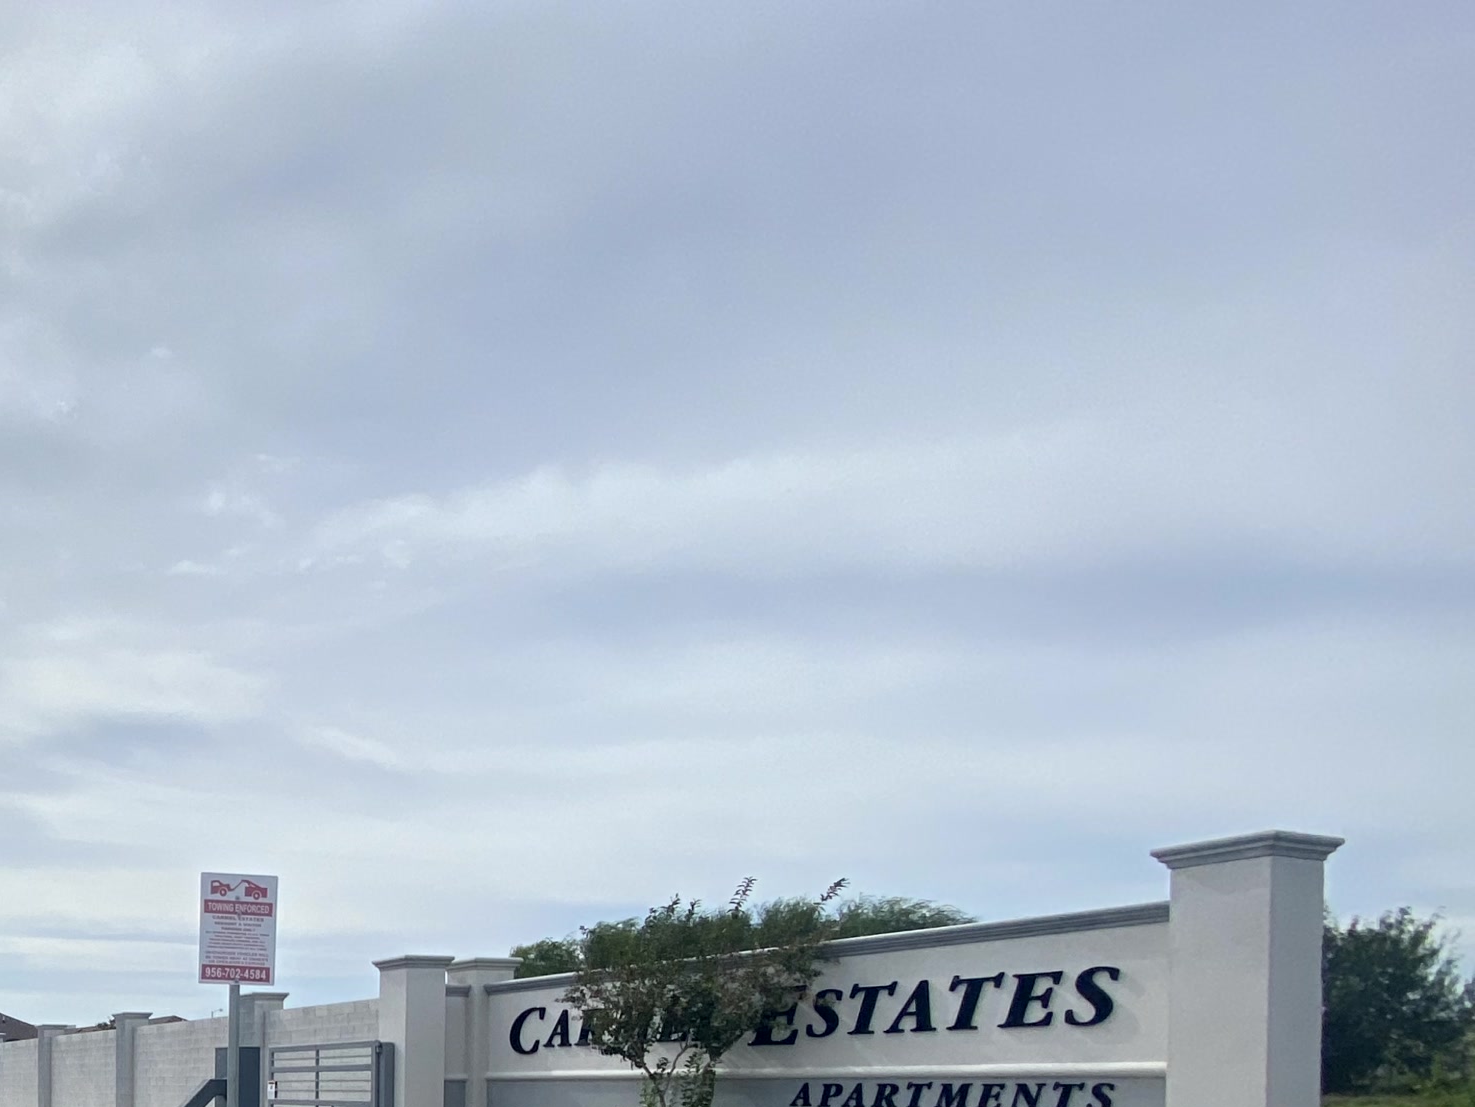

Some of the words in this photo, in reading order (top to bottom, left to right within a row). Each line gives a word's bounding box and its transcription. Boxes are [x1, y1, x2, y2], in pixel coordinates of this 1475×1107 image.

[208, 902, 234, 912] TOWING
[235, 903, 269, 914] ENFORCED
[205, 967, 266, 980] 956-702-4584
[746, 966, 1121, 1046] ESTATES
